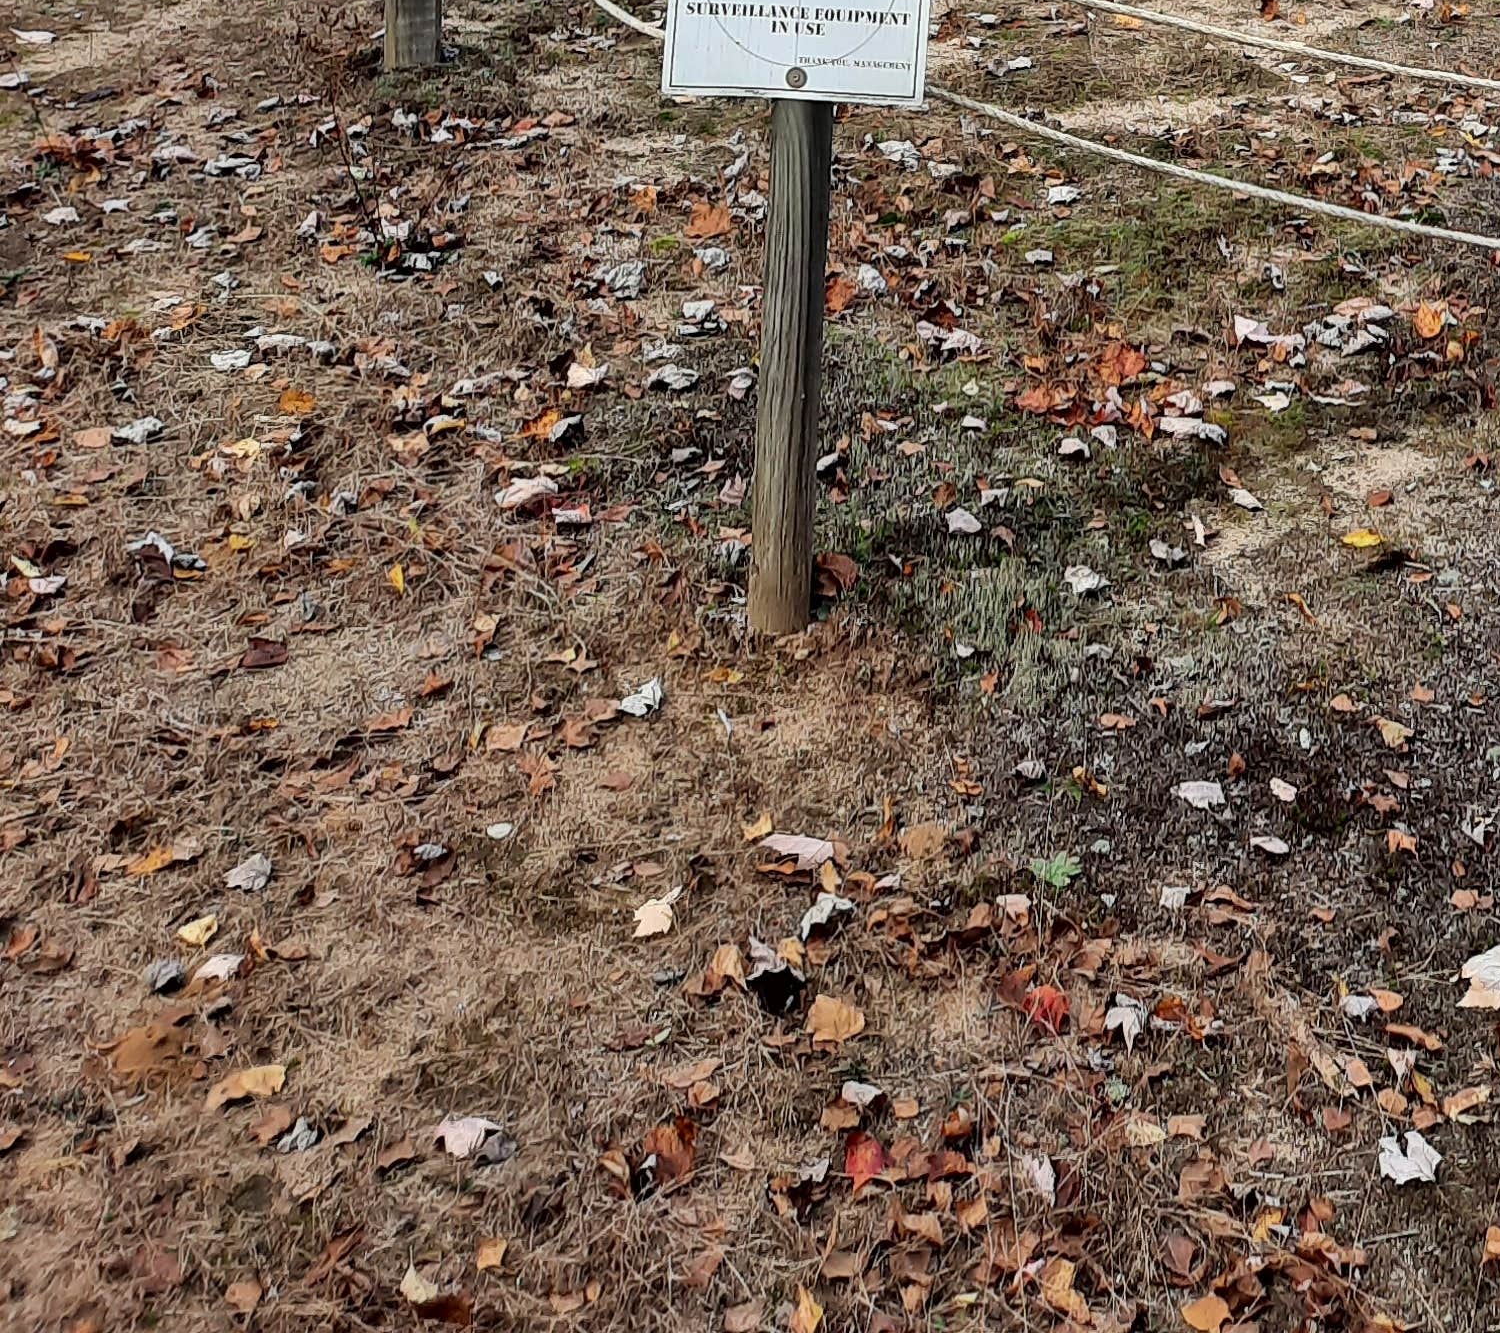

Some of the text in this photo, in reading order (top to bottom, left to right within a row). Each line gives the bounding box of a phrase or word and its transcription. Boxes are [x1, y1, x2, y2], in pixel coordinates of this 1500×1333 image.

[685, 1, 912, 26] SURVEILLANCE EQUIPMENT
[770, 20, 826, 37] IN USE
